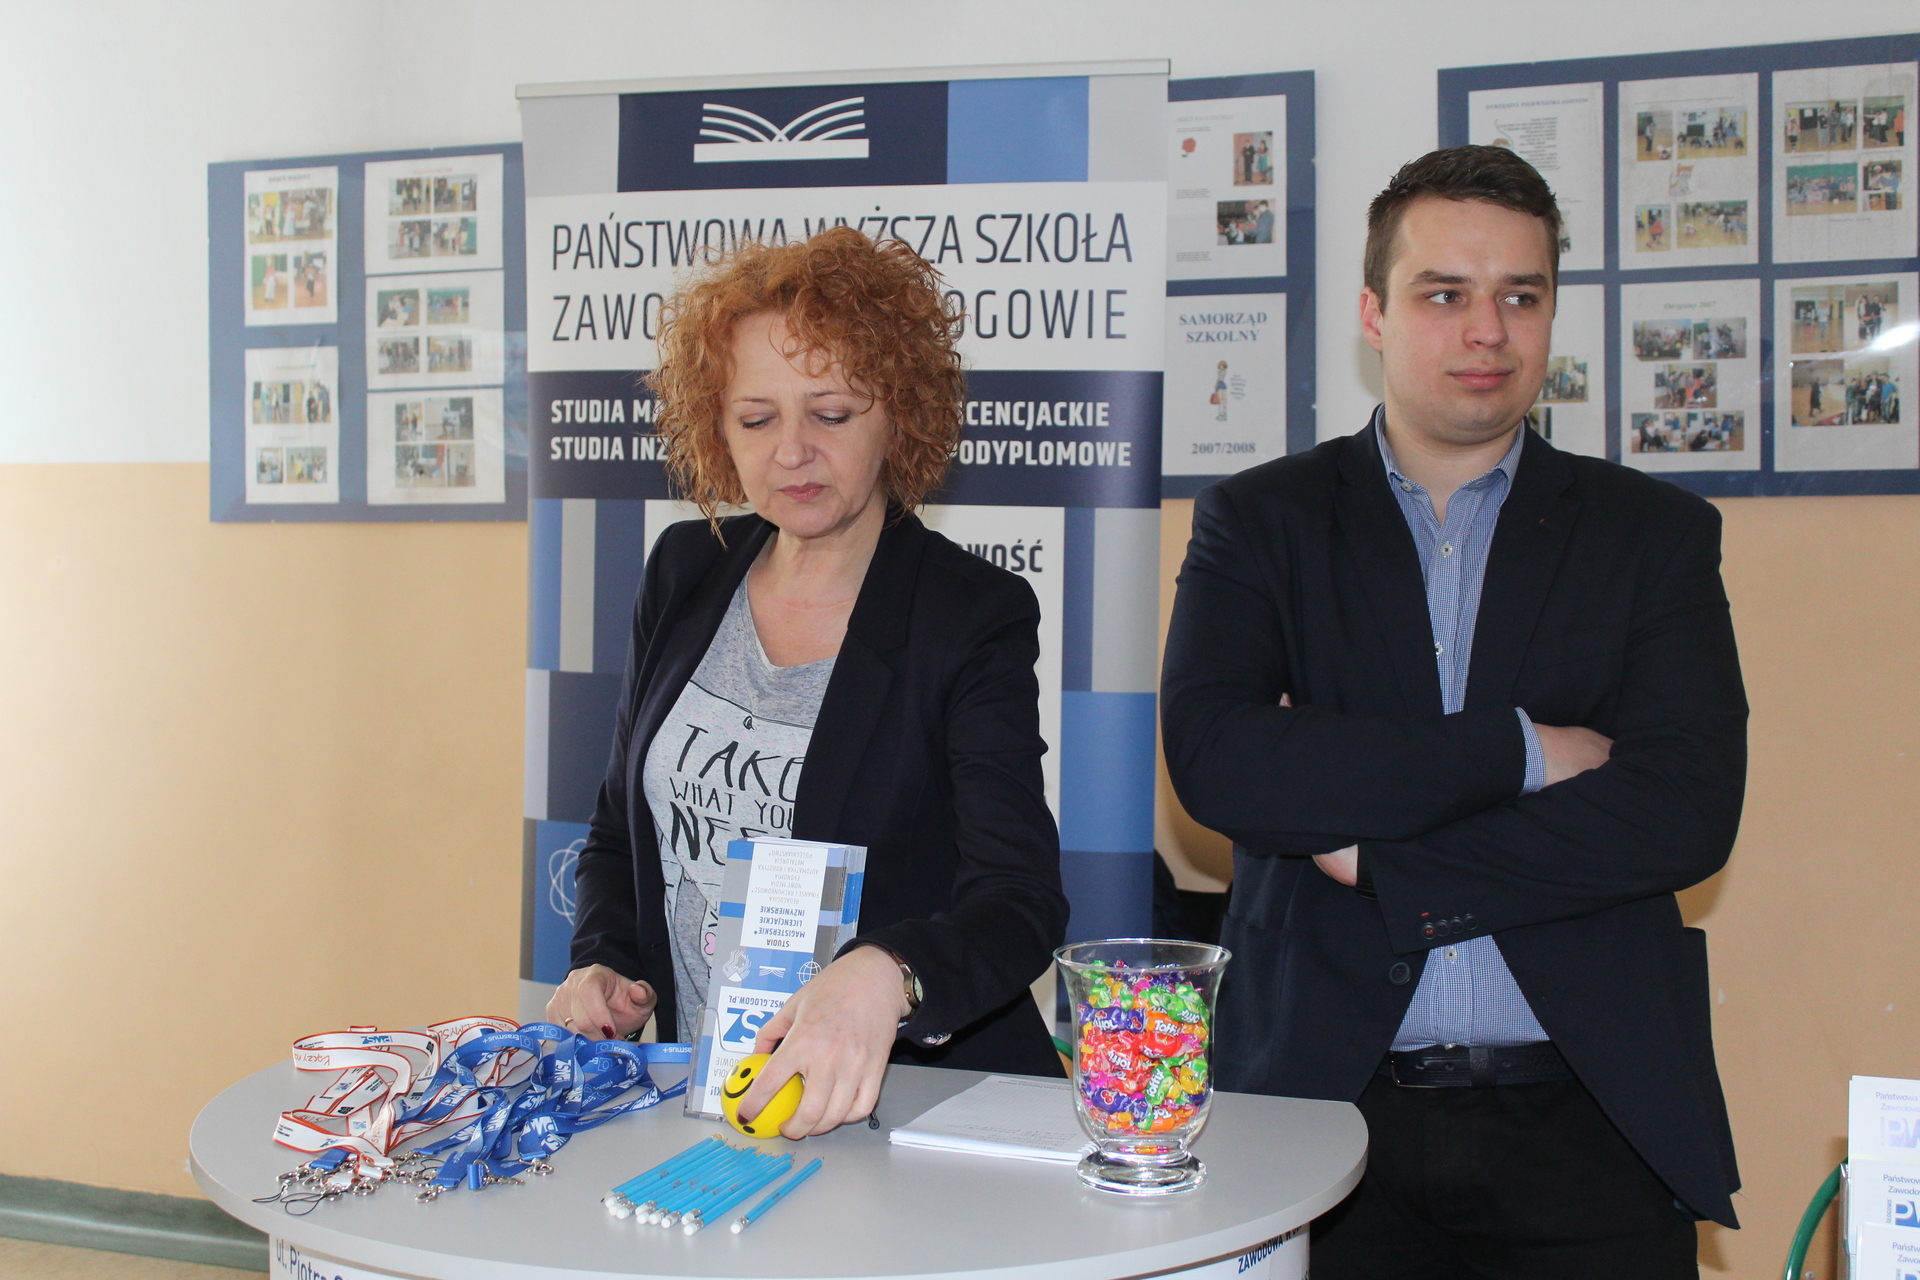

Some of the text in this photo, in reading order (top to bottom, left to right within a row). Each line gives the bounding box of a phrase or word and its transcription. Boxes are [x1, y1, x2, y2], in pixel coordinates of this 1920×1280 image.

[975, 212, 1133, 263] SZKOŁA
[552, 288, 1128, 342] ZAWO OGOWIE
[1179, 311, 1268, 327] SAMORZĄD
[1186, 328, 1260, 343] SZKOLNY
[551, 399, 625, 423] STUDIA
[965, 401, 1110, 430] CENCJACKIE
[550, 436, 625, 460] STUDIA
[1191, 442, 1256, 455] 2007/2008
[669, 777, 736, 816] WHAT
[759, 916, 803, 927] LICENCJACKIE
[766, 938, 790, 948] STUDIA
[360, 1035, 393, 1045] PWSZ
[482, 1033, 520, 1044] Erasmus+
[662, 1046, 692, 1054] asmus+
[1883, 1173, 1920, 1184] Państwow
[1887, 1185, 1920, 1196] Zawodo
[1892, 1241, 1920, 1252] Państw
[1238, 1234, 1284, 1274] ZAWODOWA
